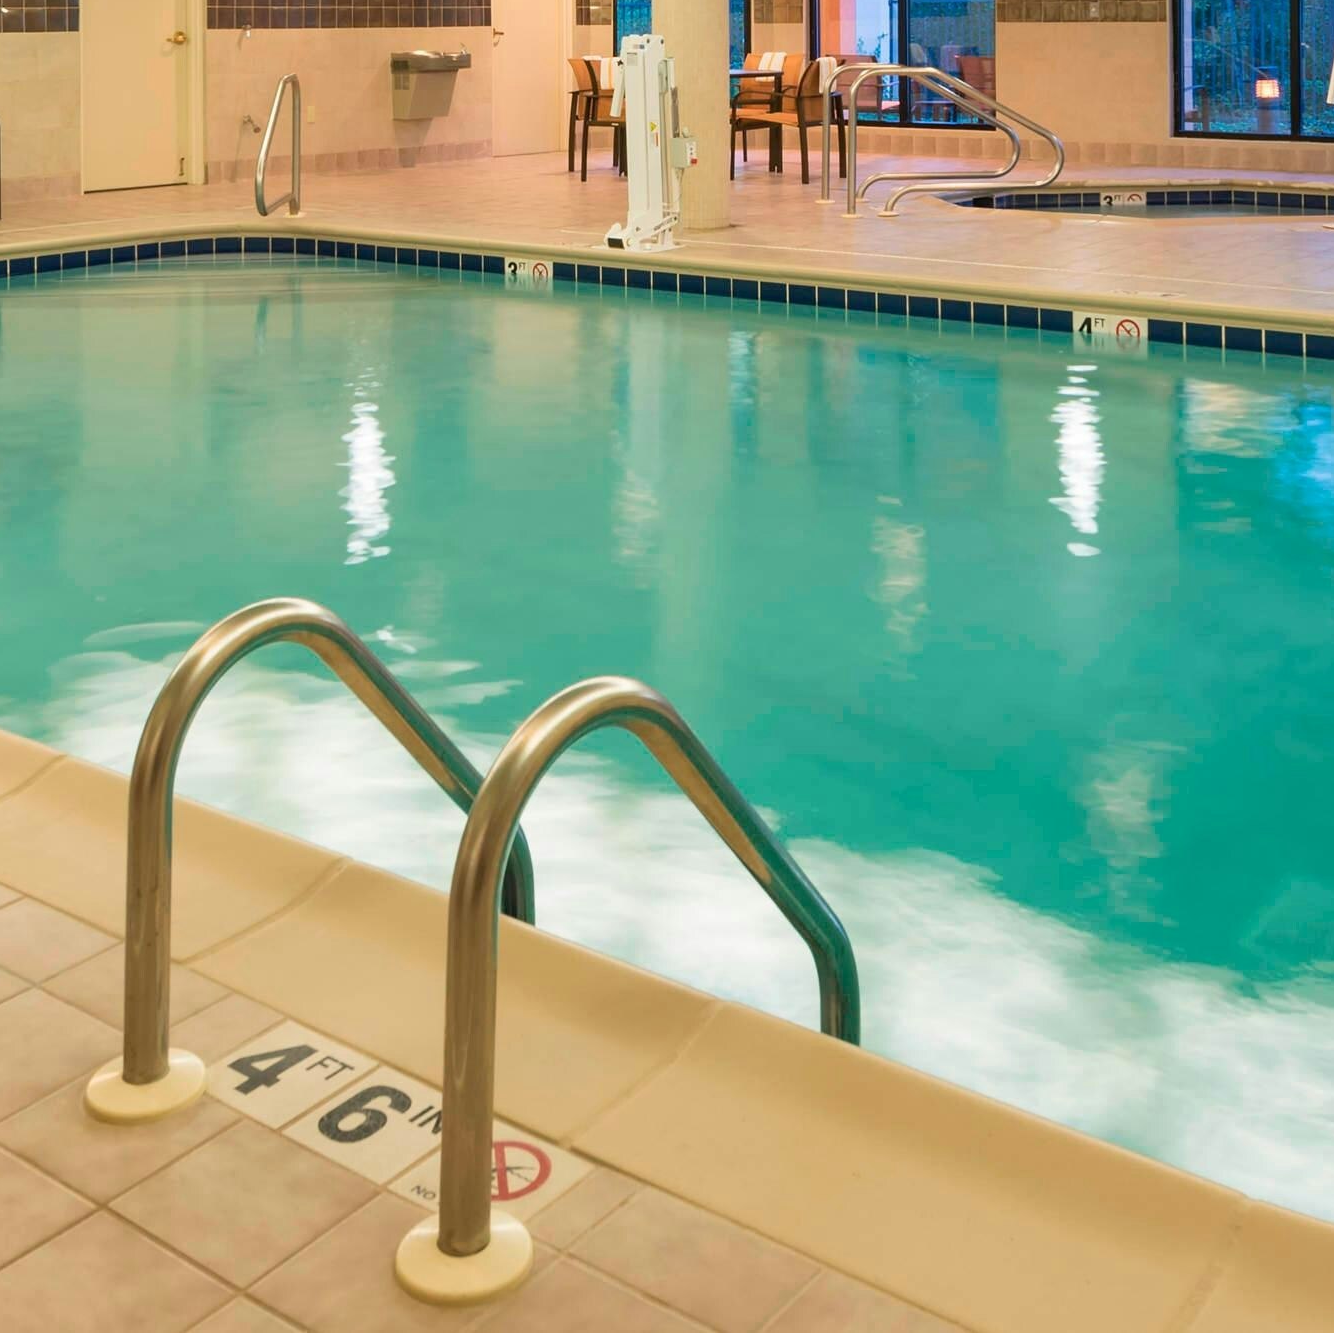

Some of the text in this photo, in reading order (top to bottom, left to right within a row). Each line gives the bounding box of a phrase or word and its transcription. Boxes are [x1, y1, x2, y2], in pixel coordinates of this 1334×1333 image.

[508, 261, 517, 275] 3
[1094, 318, 1105, 328] FT
[226, 1043, 443, 1144] 4 FT 6 IN
[410, 1184, 437, 1201] NO
